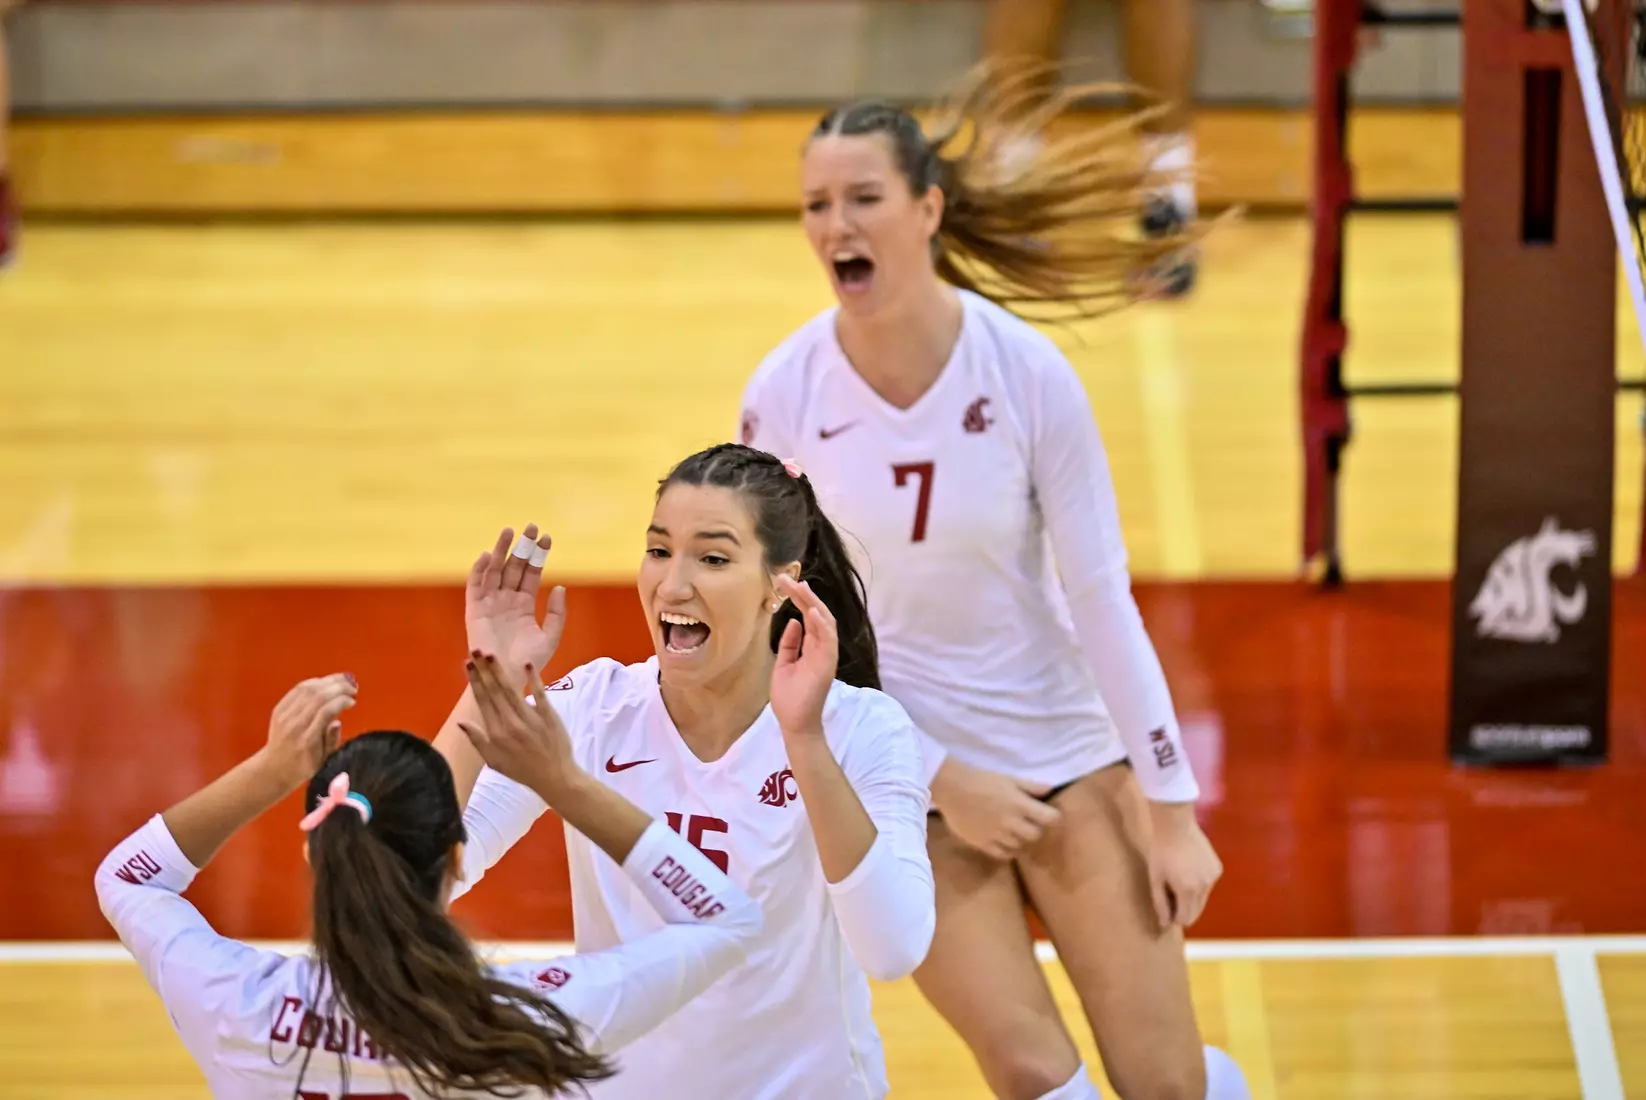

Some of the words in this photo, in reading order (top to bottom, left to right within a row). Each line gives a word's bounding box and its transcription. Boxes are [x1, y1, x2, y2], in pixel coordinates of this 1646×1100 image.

[891, 462, 935, 542] 7
[1149, 725, 1177, 769] WSU
[115, 850, 162, 885] WSU
